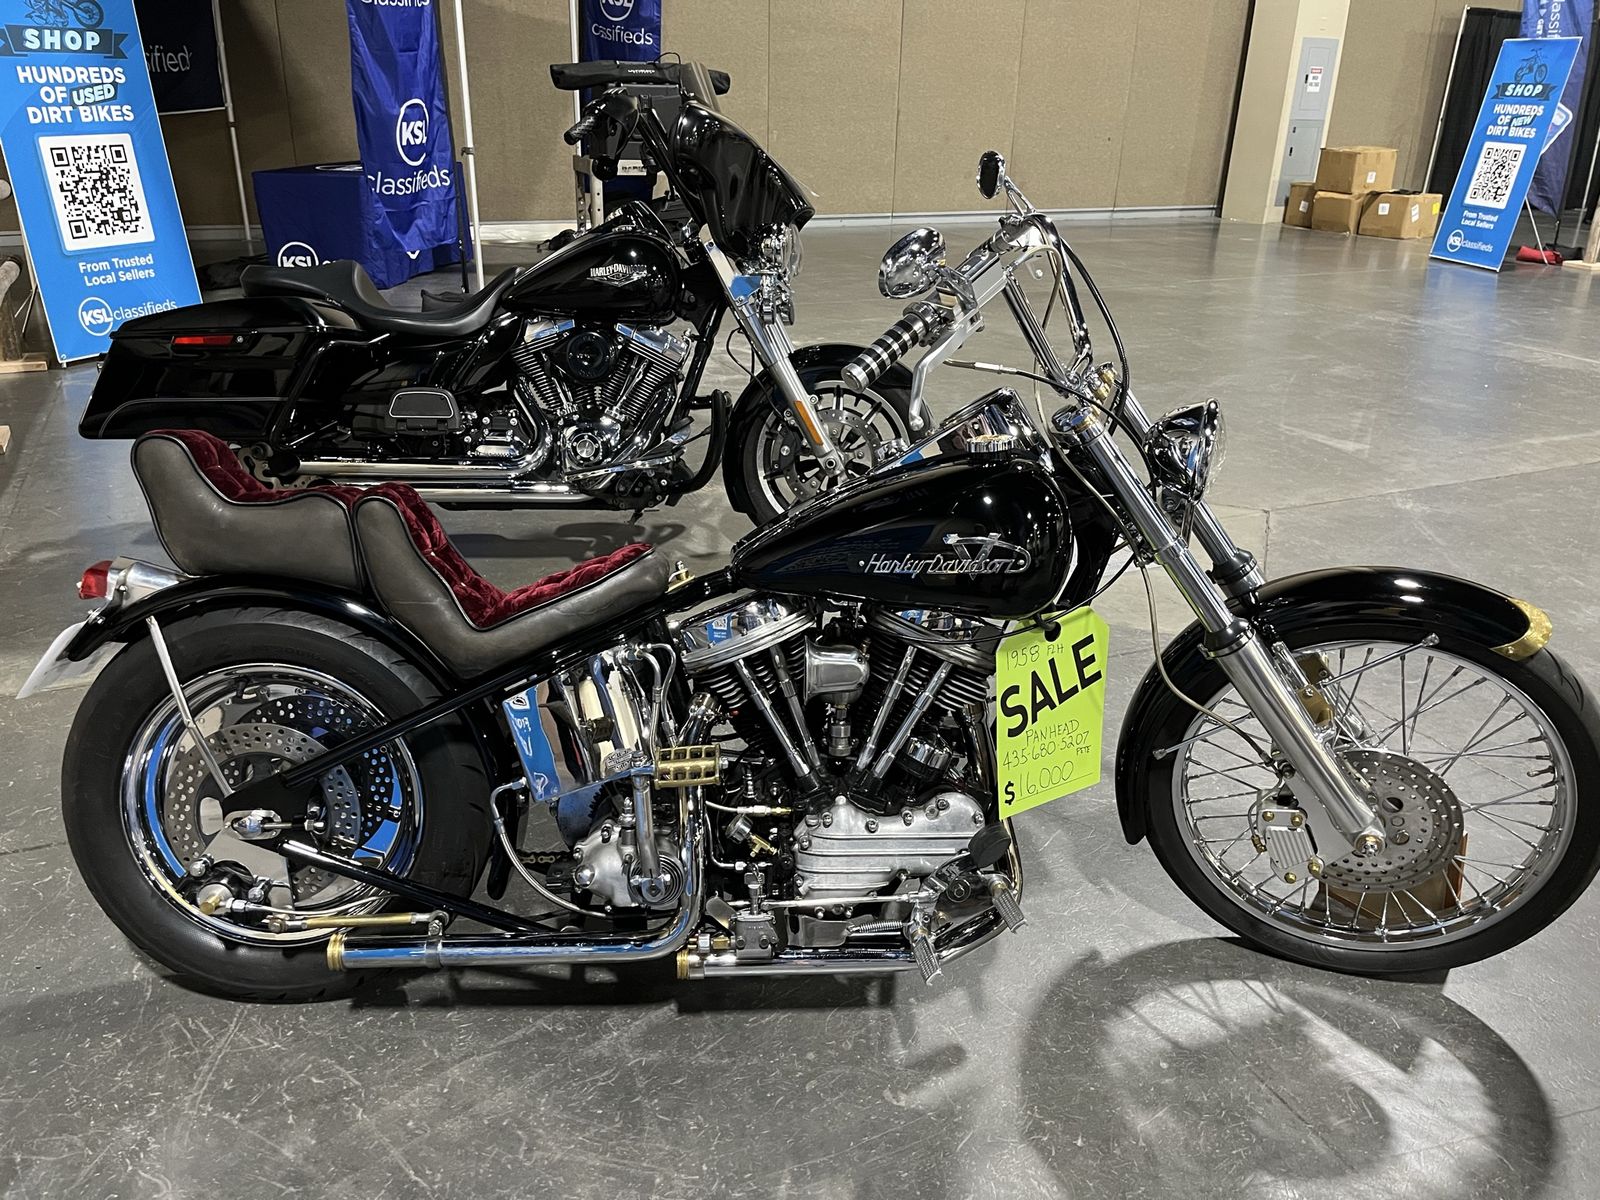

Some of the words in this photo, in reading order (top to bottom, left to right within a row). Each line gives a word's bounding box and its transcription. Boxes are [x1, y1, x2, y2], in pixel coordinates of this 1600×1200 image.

[23, 27, 102, 51] SHOP
[16, 65, 126, 84] HUNDREDS
[40, 86, 68, 104] OF
[72, 83, 116, 106] USED
[1504, 84, 1543, 97] SHOP
[27, 106, 73, 124] DIRT
[80, 105, 135, 124] BIKES
[1493, 103, 1545, 116] HUNDREDS
[1497, 115, 1511, 125] OF
[1511, 115, 1533, 127] NEW
[1486, 125, 1508, 136] DIRT
[1508, 126, 1537, 138] BIKES
[1461, 218, 1476, 227] Local
[1476, 221, 1494, 230] Sellers
[1463, 210, 1478, 219] From
[1478, 212, 1499, 222] Trusted
[78, 260, 111, 274] From
[112, 254, 154, 271] Trusted
[84, 271, 117, 287] Local
[118, 268, 155, 283] Sellers
[82, 307, 113, 327] KSL
[1005, 644, 1041, 671] 1958
[1000, 634, 1103, 738] SALE
[1025, 718, 1080, 747] PANHEAD
[1076, 745, 1092, 756] PETE
